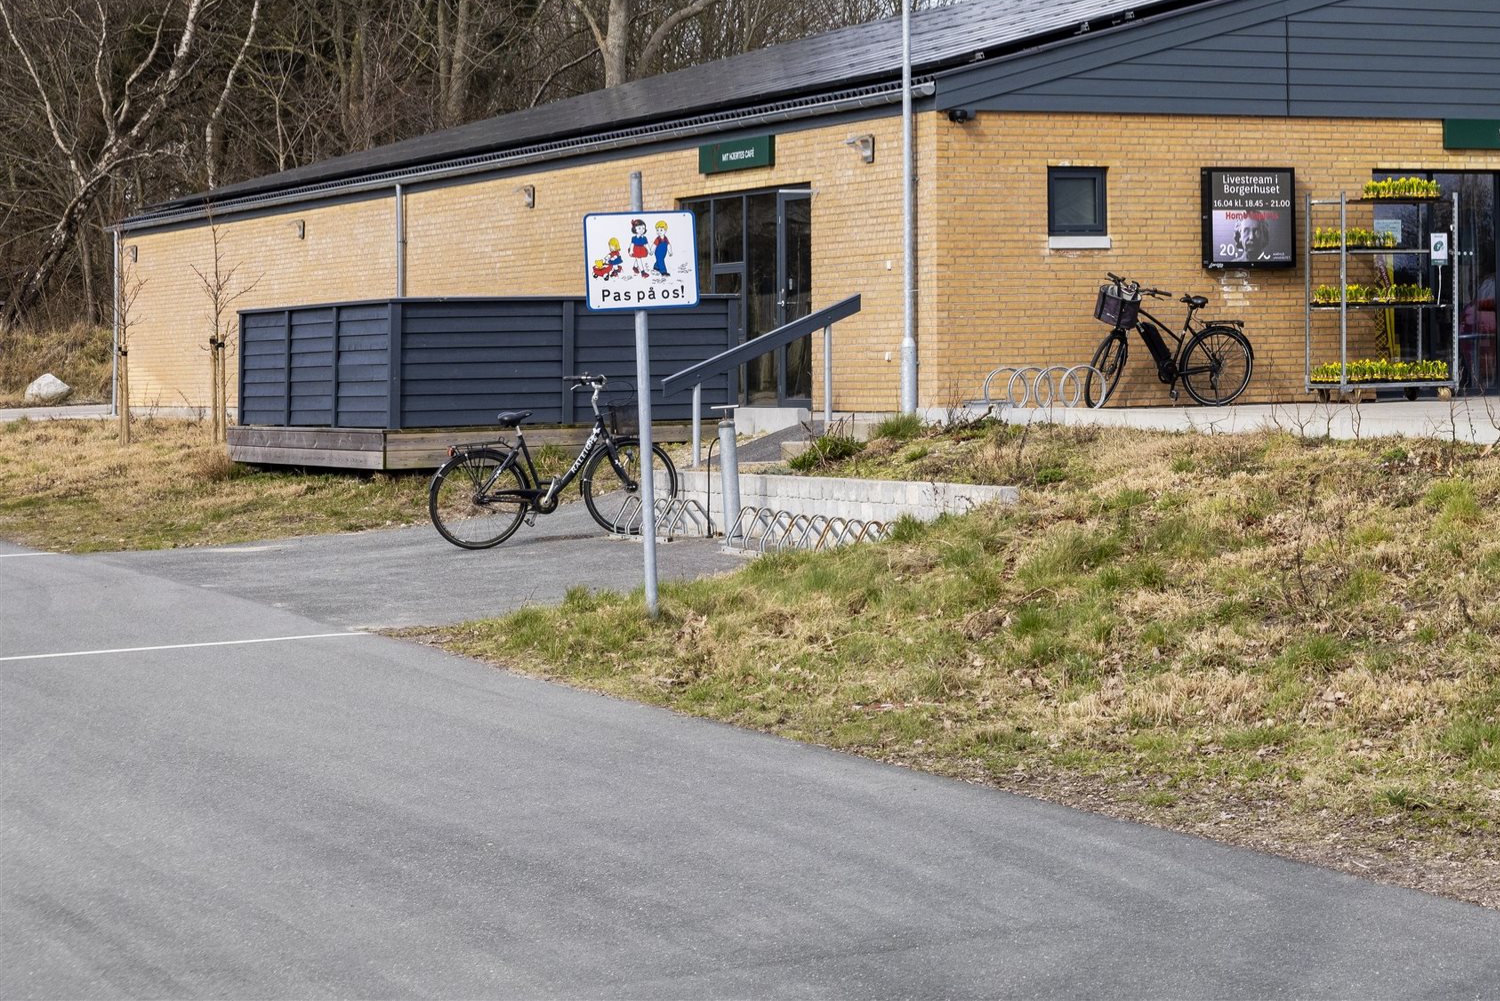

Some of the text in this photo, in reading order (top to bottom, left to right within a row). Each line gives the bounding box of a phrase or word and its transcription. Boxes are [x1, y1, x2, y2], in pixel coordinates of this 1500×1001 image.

[1222, 173, 1273, 184] Livestream
[1223, 184, 1280, 196] Borgerhuset
[1213, 199, 1233, 208] 16.04
[1245, 199, 1264, 207] 18.45
[1270, 199, 1291, 208] 21.00
[1219, 243, 1244, 258] 20,-
[601, 284, 685, 303] Pas på os!
